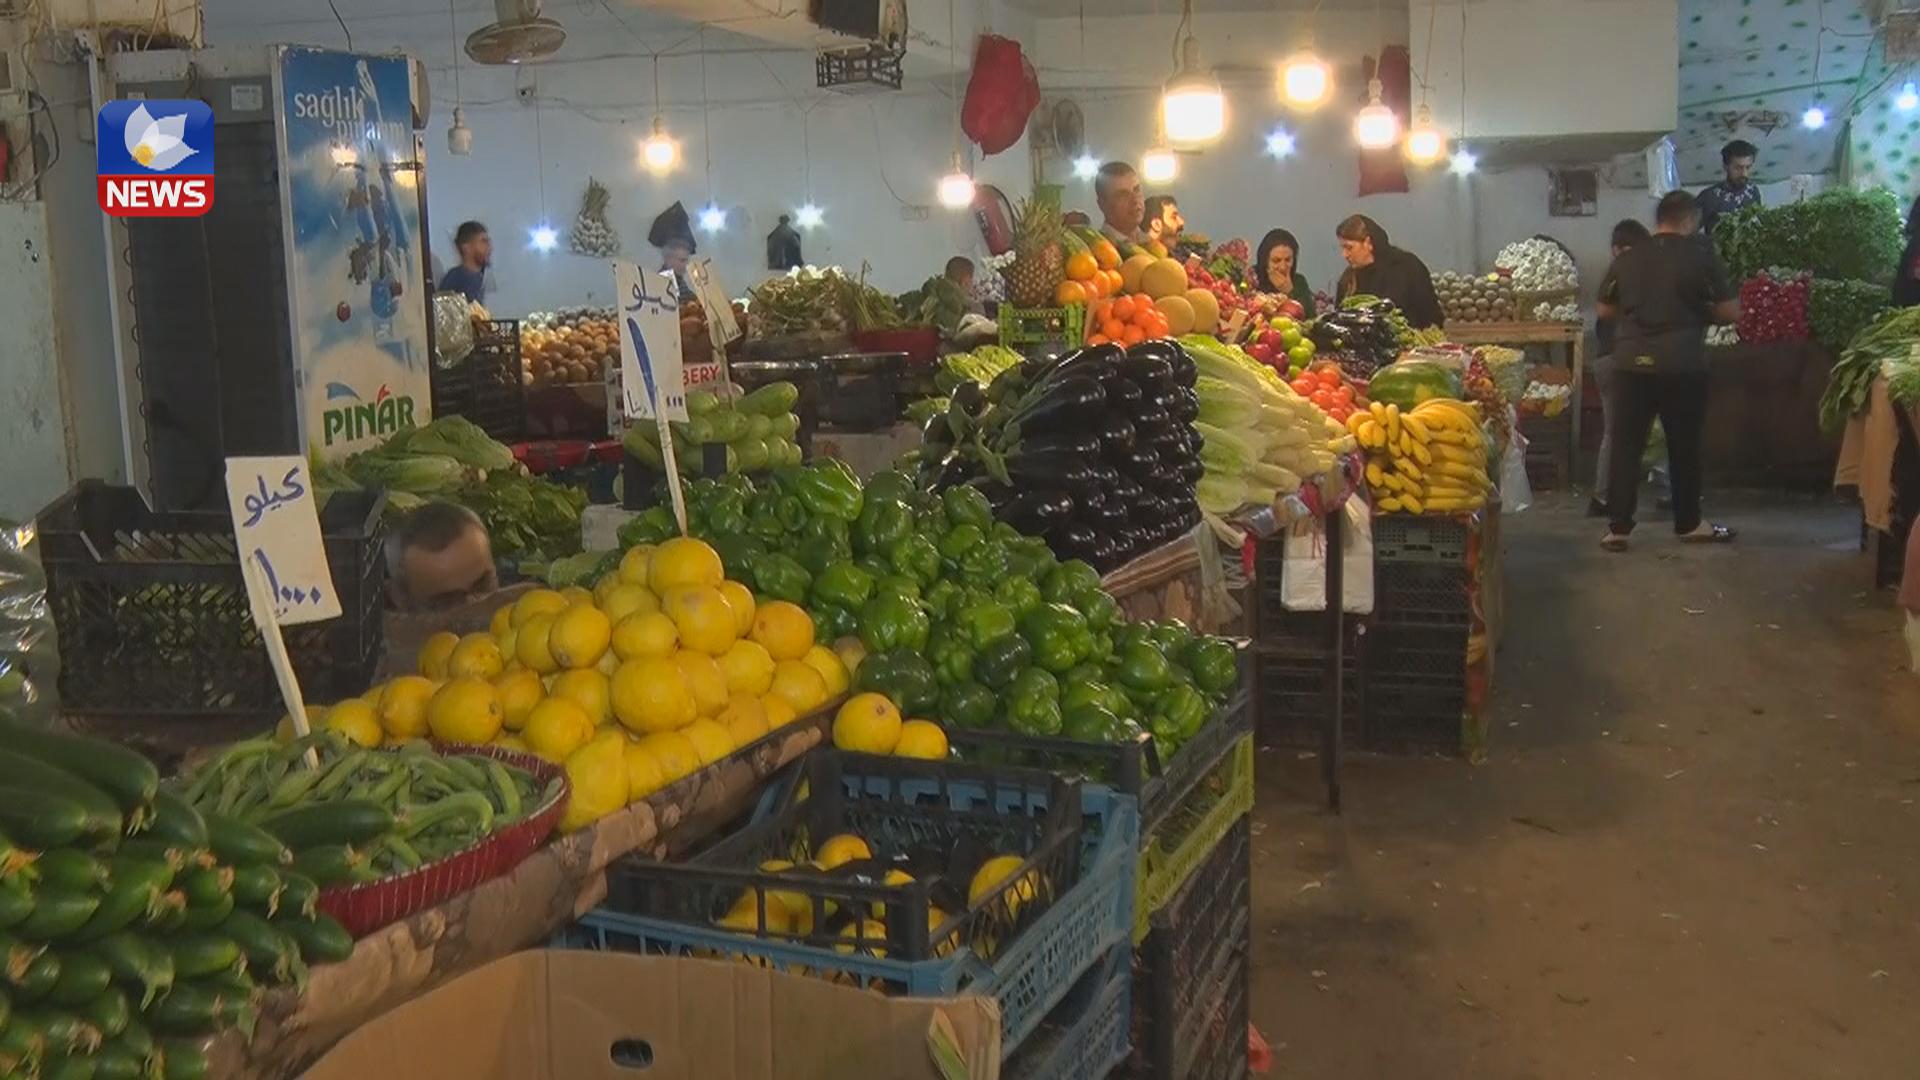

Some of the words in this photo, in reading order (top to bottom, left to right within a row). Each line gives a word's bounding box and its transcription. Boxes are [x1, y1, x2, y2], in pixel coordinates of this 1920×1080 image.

[625, 266, 677, 315] كيلو
[323, 396, 417, 447] PINAR
[242, 466, 305, 528] كيلو
